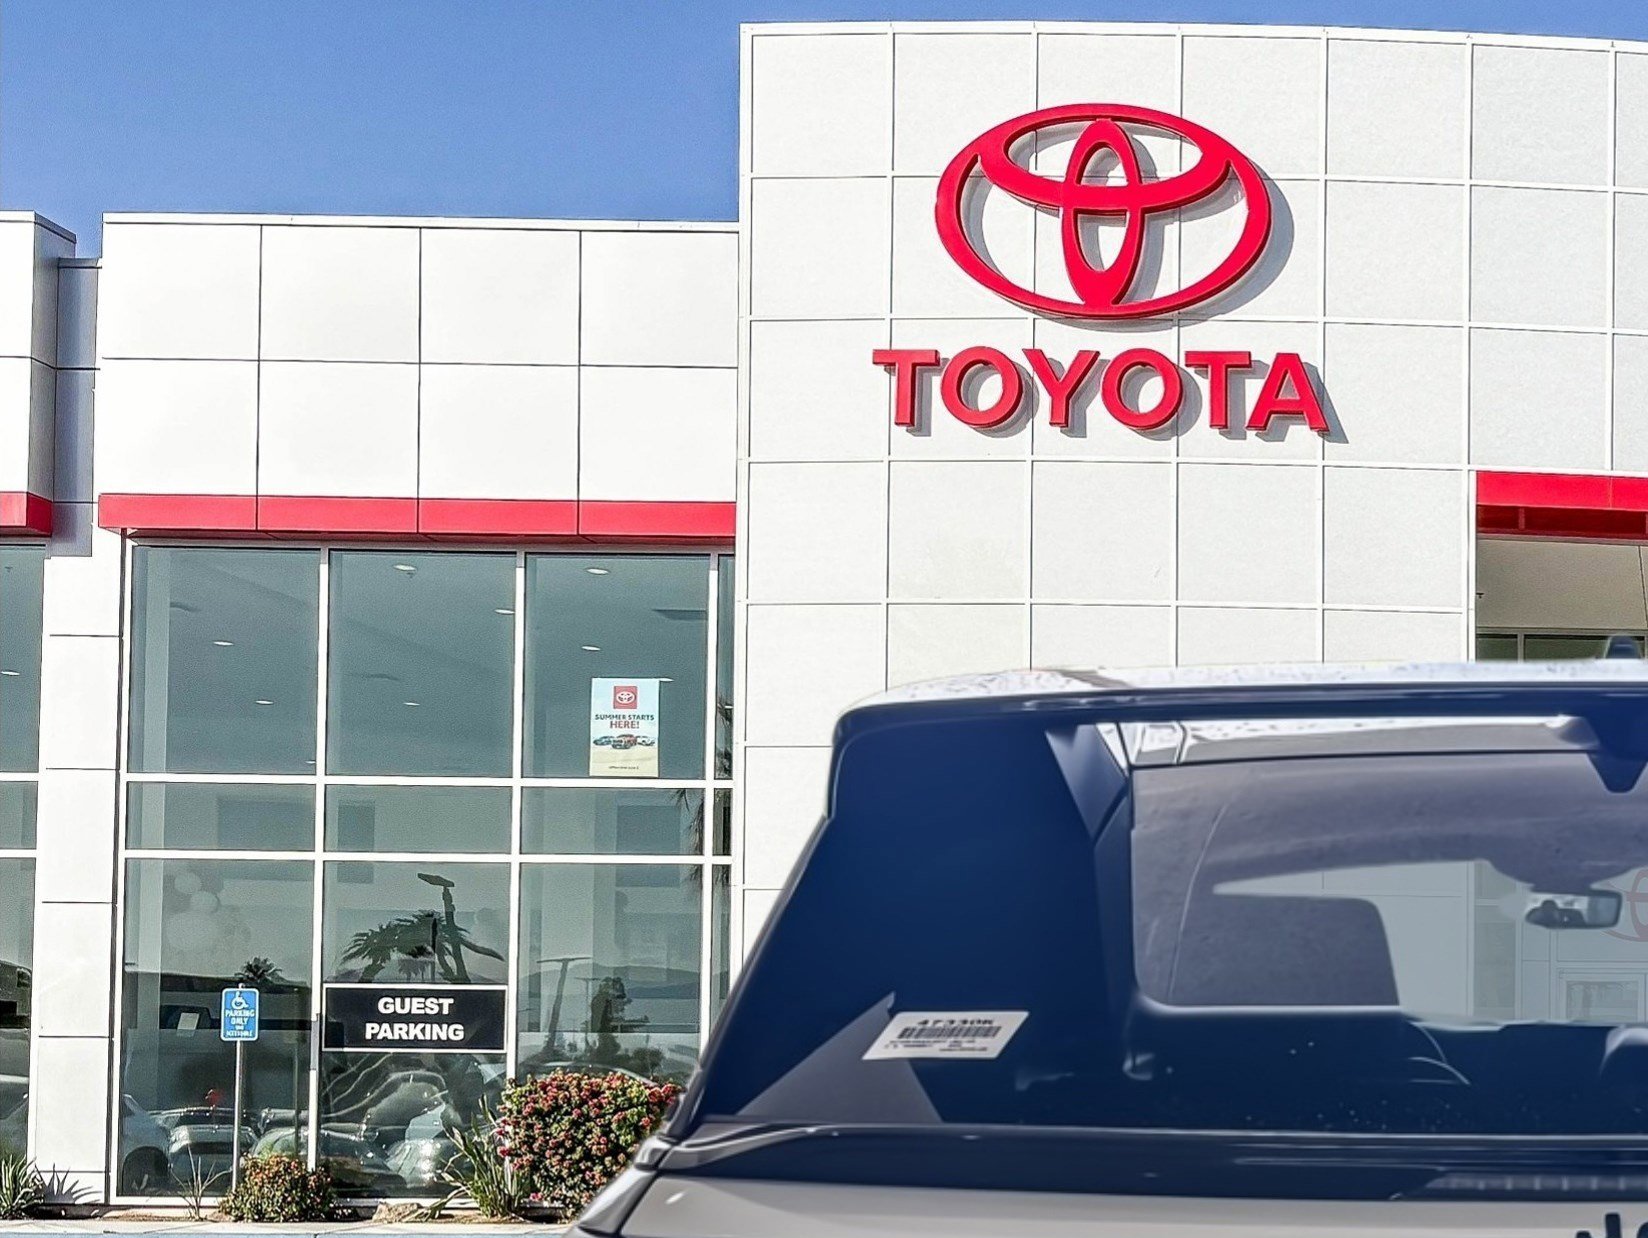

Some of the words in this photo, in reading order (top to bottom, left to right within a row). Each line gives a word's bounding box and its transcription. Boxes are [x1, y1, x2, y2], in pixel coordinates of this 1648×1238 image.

[872, 346, 1328, 433] TOYOTA
[609, 720, 640, 729] HERE!
[377, 997, 454, 1015] GUEST
[225, 1009, 255, 1017] PARKING
[230, 1017, 248, 1025] ONLY
[365, 1023, 465, 1041] PARKING
